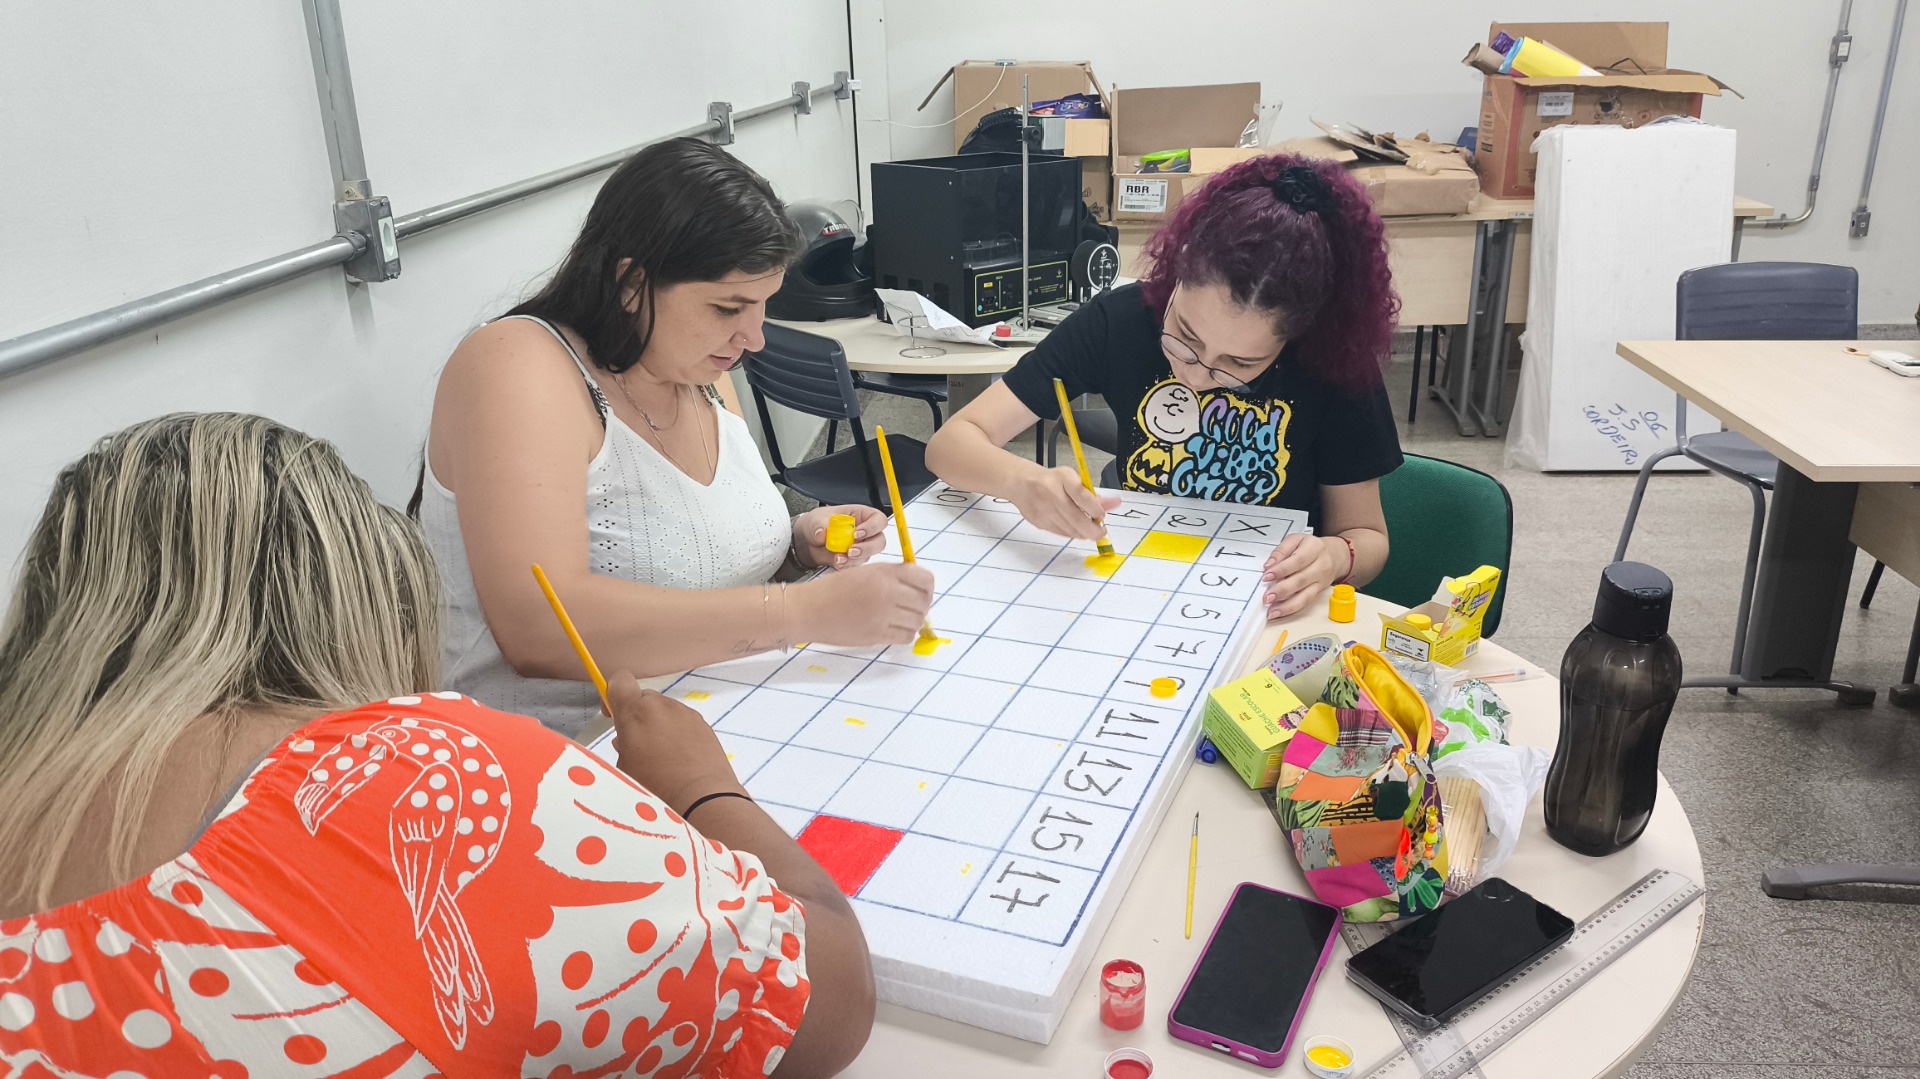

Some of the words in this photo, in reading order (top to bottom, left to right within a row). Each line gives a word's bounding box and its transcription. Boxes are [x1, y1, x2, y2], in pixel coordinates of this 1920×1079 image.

[1126, 185, 1150, 193] RBR
[1214, 546, 1256, 558] 1
[1200, 572, 1239, 587] 3
[1181, 603, 1221, 619] 5
[1154, 640, 1206, 657] 7
[1095, 708, 1159, 740] 11
[1063, 750, 1133, 796] 13
[1030, 806, 1094, 852] 15
[989, 860, 1061, 914] 17
